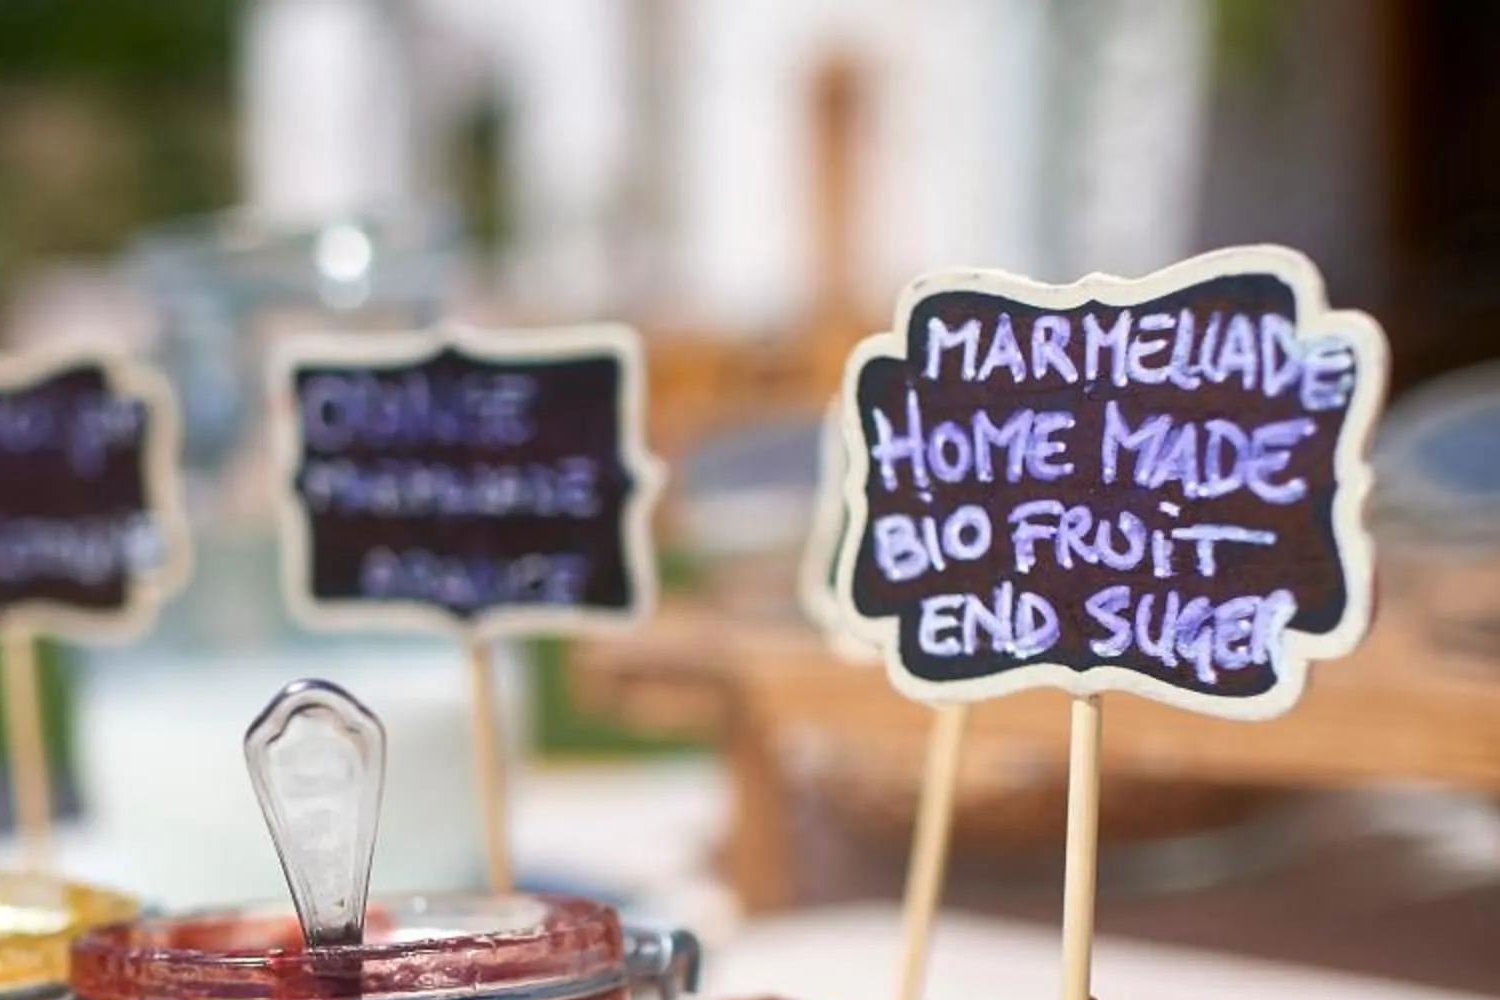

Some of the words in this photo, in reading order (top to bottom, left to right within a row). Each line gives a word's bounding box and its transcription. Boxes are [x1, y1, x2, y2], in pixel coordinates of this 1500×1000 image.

[871, 388, 1076, 502] HOME
[1102, 400, 1316, 502] MADE
[874, 503, 993, 582] BIO
[918, 580, 1061, 660] END
[1085, 585, 1299, 685] SUGER
